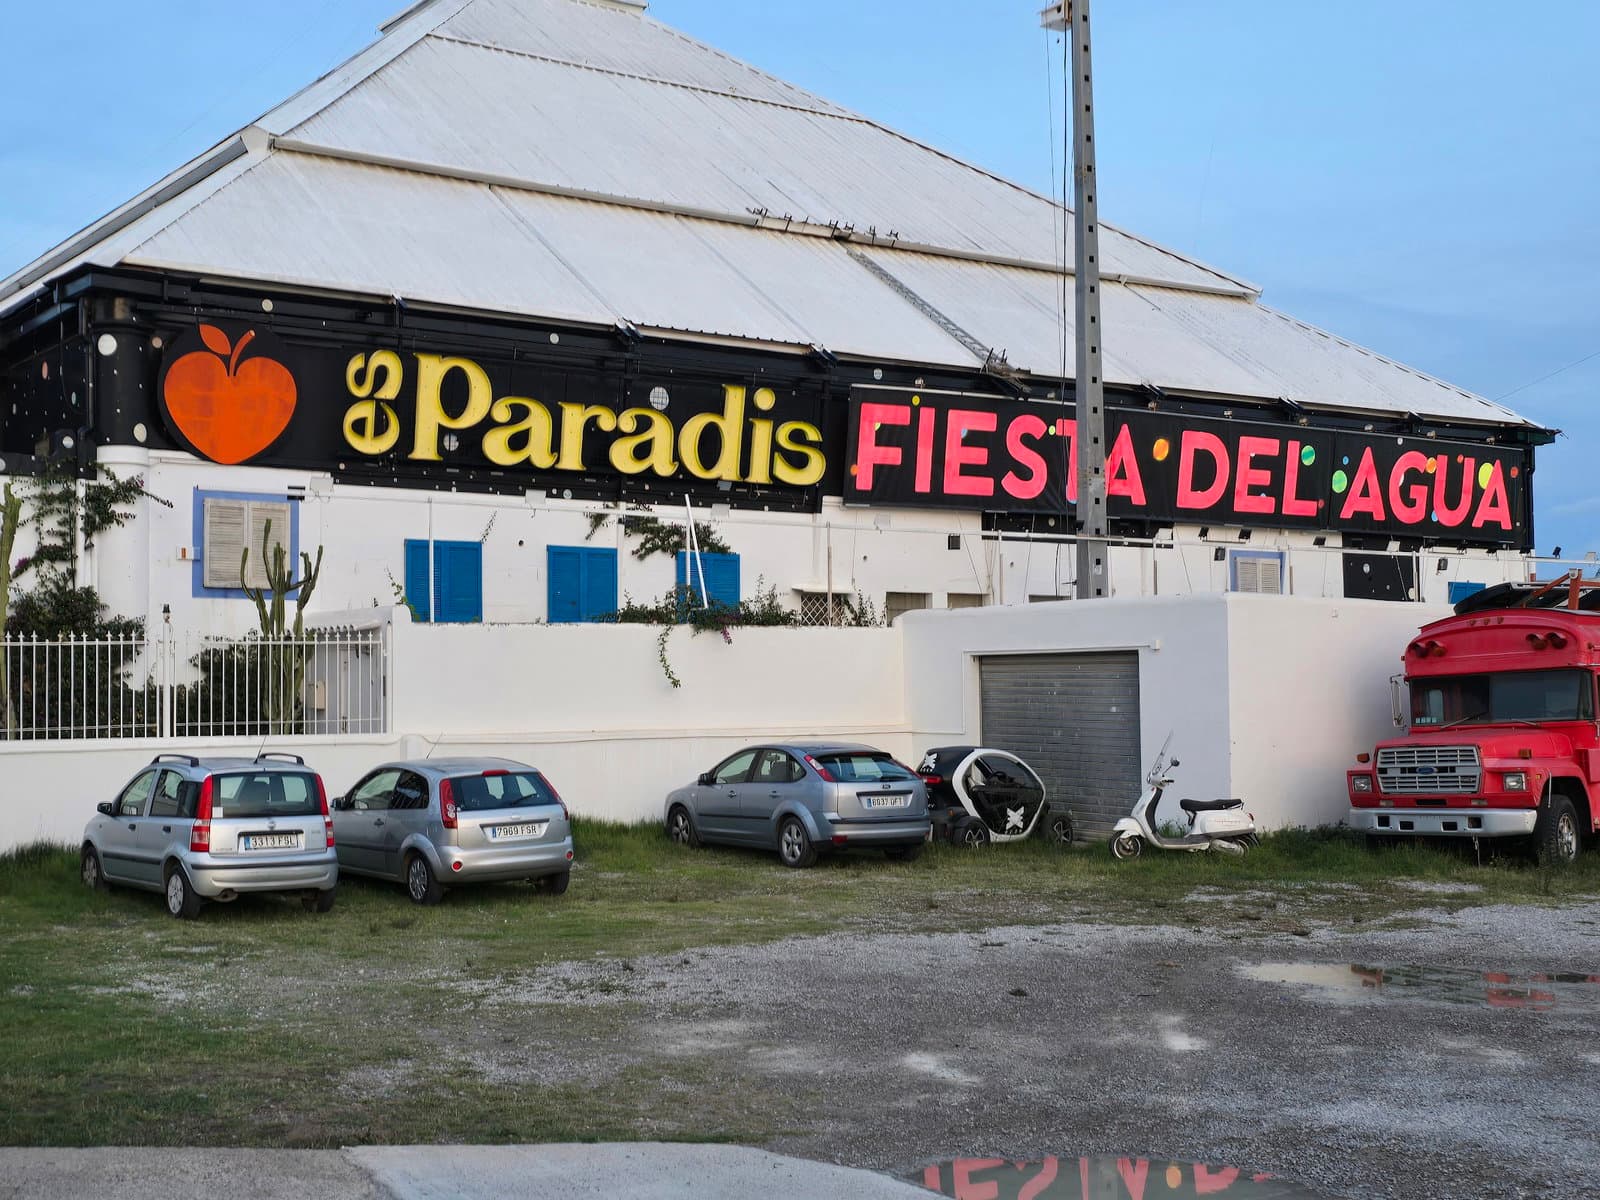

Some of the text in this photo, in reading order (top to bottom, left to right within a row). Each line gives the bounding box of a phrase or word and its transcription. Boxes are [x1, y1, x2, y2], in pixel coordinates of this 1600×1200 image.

[344, 350, 827, 486] es Paradis
[1177, 430, 1319, 517] DEL
[1340, 446, 1513, 530] AGUA
